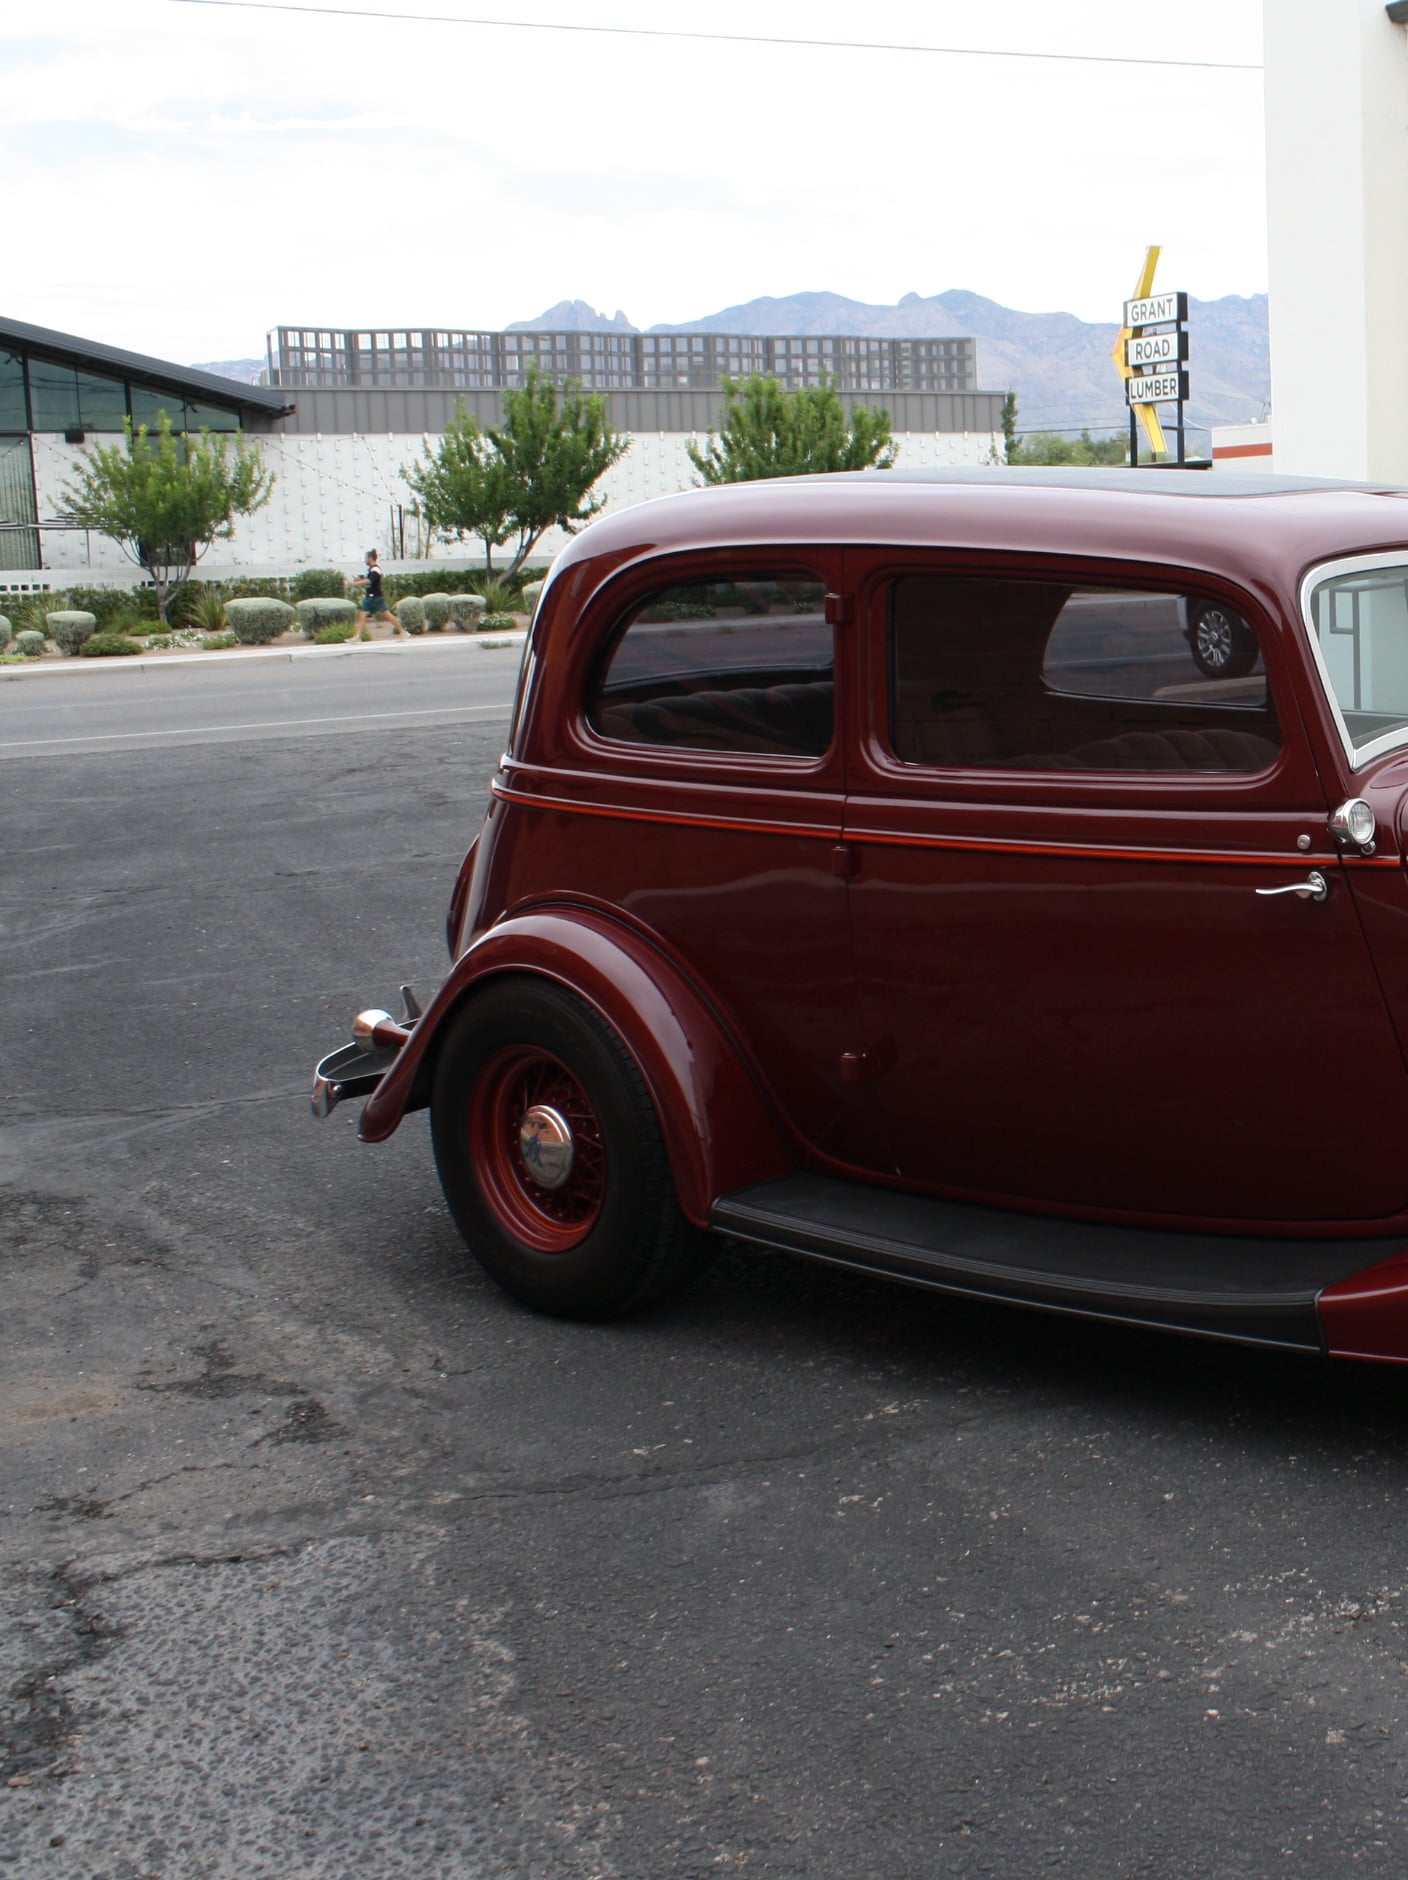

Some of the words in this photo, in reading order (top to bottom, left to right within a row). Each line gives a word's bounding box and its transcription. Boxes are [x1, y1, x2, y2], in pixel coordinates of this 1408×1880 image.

[1132, 299, 1173, 321] GRANT
[1135, 339, 1170, 361] ROAD
[1131, 378, 1177, 399] LUMBER
